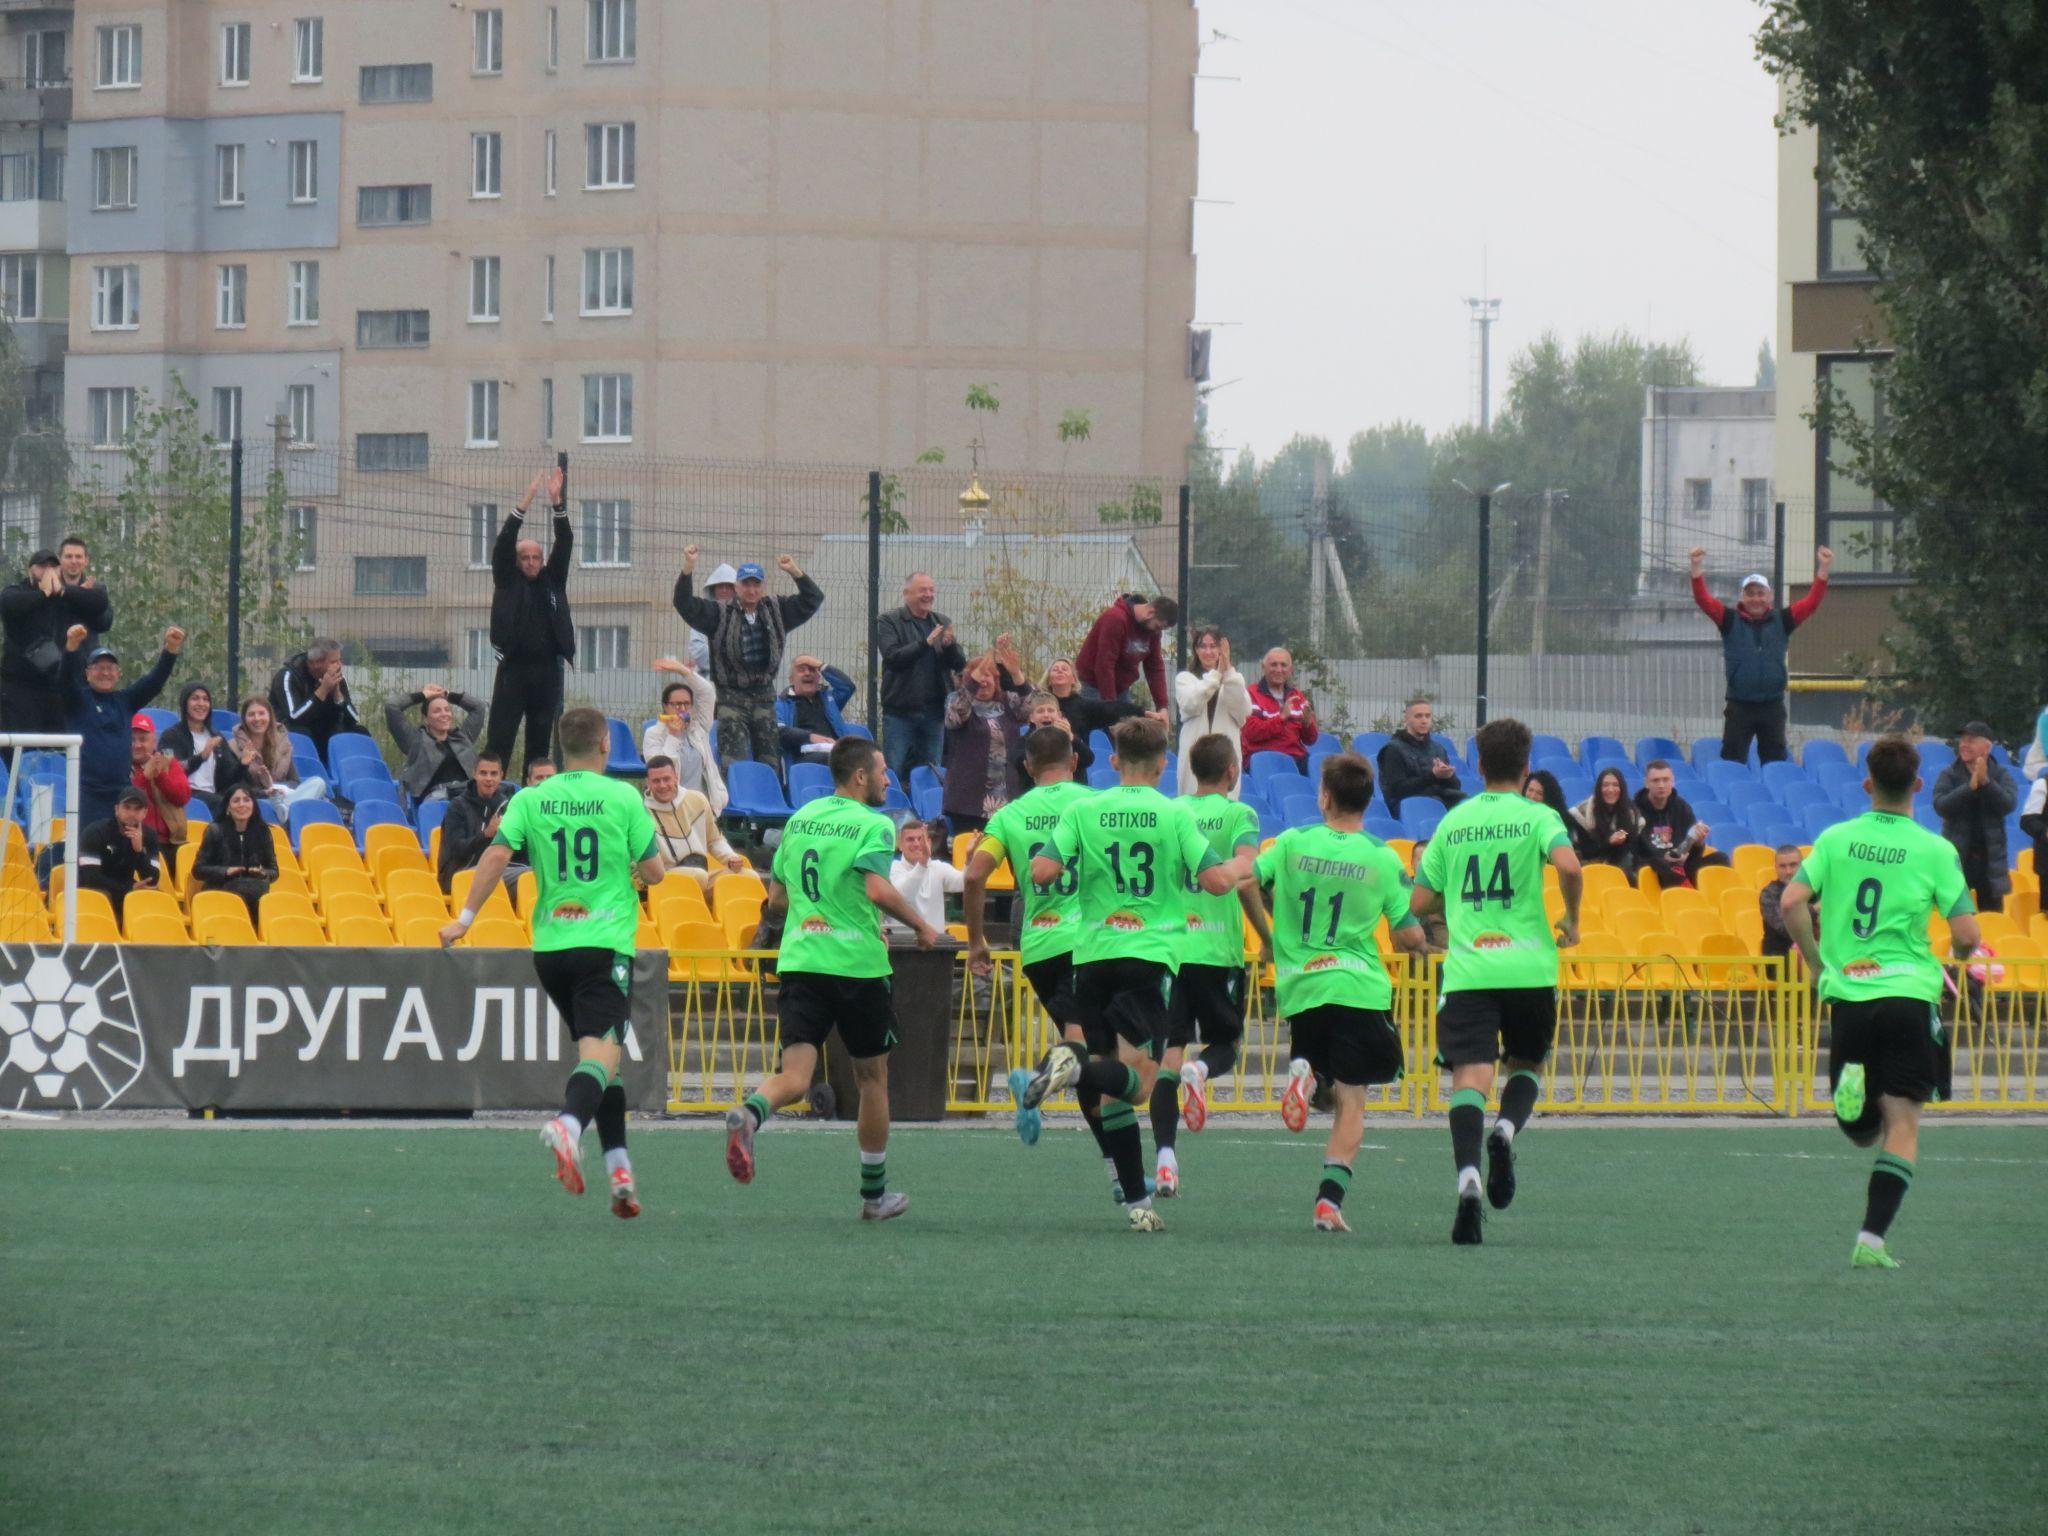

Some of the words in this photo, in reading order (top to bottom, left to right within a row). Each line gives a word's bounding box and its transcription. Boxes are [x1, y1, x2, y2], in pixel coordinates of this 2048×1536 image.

[540, 799, 605, 817] МЕЛЬНИК
[1025, 814, 1061, 831] БОРЯ
[1100, 812, 1157, 828] ЄВТІХОВ
[1199, 817, 1223, 831] ЬКО
[551, 826, 599, 882] 19
[1446, 821, 1531, 848] КОРЕНЖЕНКО
[1847, 841, 1907, 866] КОБЦОВ
[801, 848, 821, 903] 6
[1104, 841, 1155, 898] 13
[1298, 855, 1367, 881] ПЕТЛЕНКО
[1461, 852, 1515, 912] 44
[1299, 886, 1345, 946] 11
[1852, 877, 1883, 939] 9
[172, 985, 444, 1078] ДРУГА
